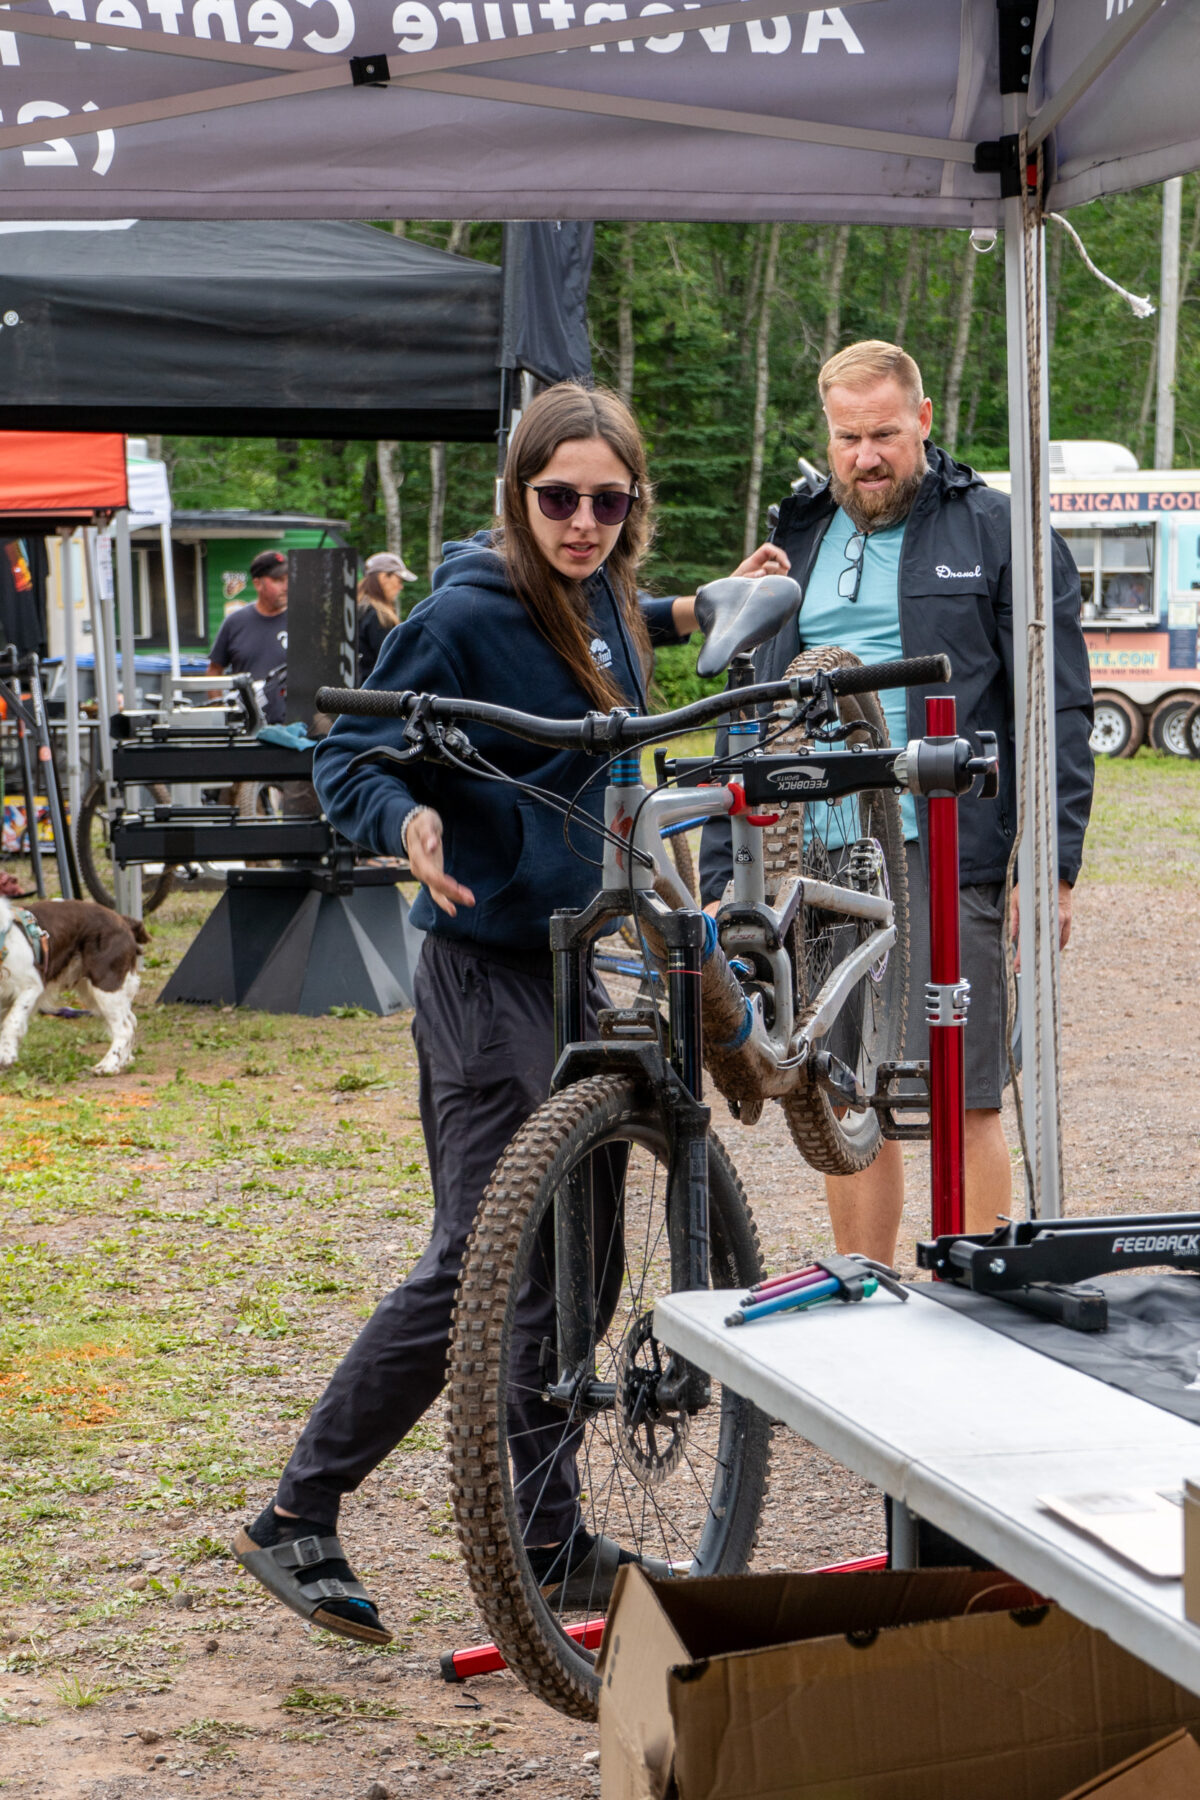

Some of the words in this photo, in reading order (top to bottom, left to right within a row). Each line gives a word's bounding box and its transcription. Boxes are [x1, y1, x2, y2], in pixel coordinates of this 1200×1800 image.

[1088, 652, 1155, 665] TE.COM
[777, 779, 829, 791] FEEDBACK
[1112, 1235, 1200, 1253] FEEDBACK
